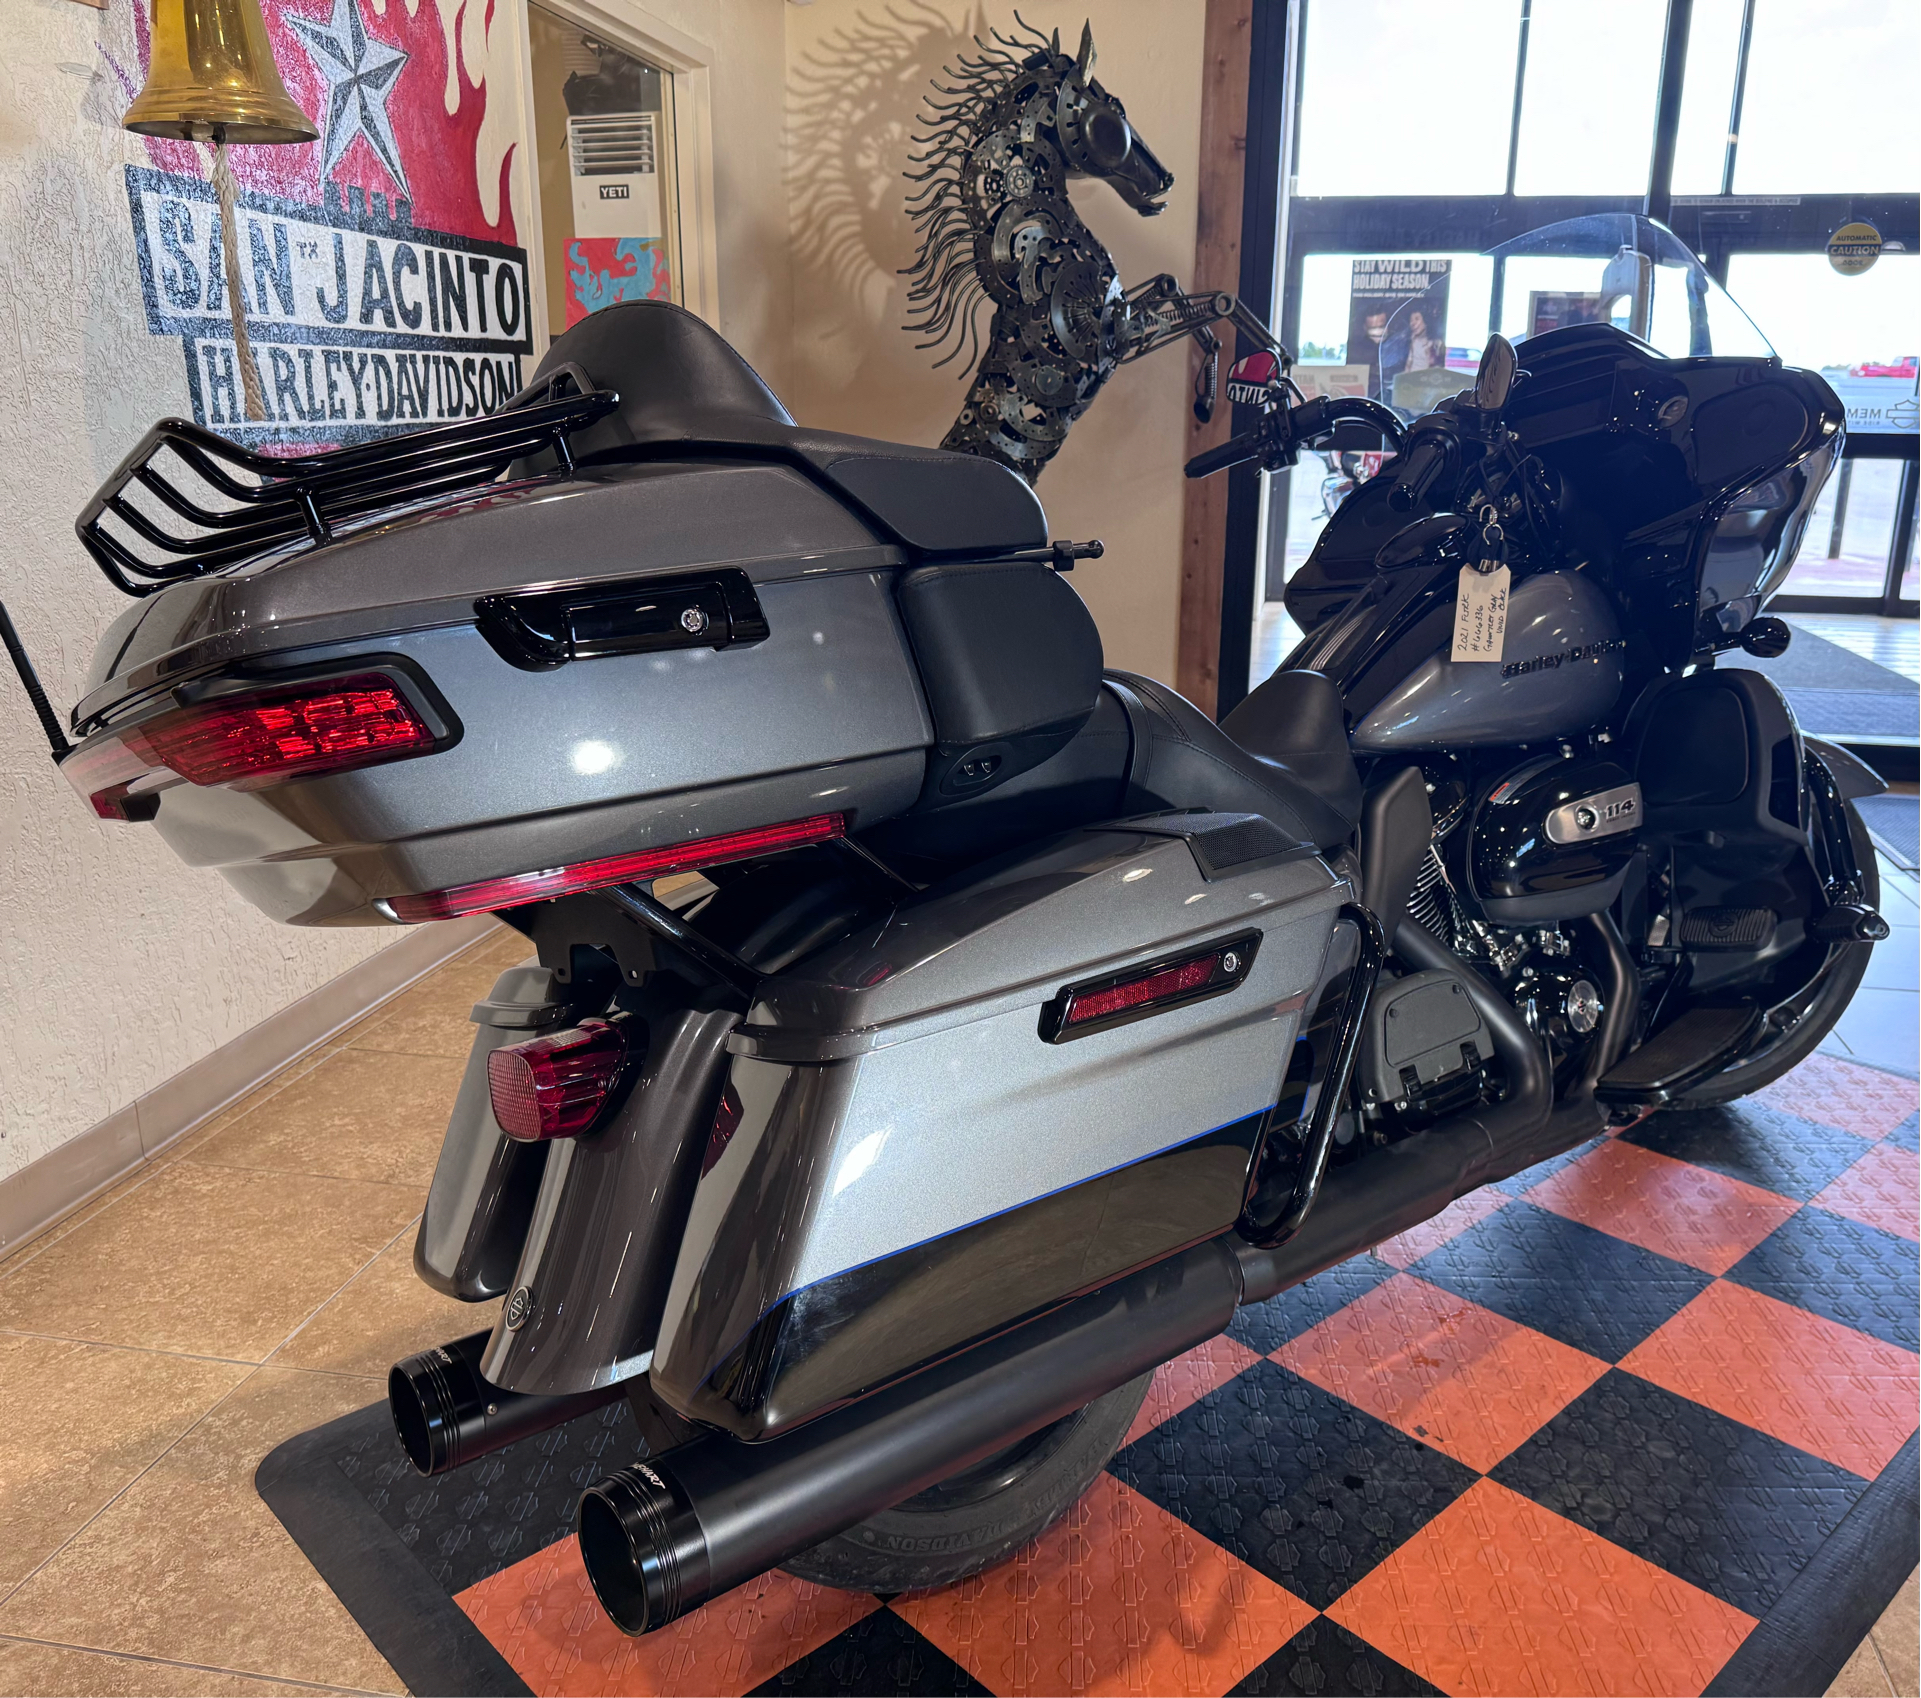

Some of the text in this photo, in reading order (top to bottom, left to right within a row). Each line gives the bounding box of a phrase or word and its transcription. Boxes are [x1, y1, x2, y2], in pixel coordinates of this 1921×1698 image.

[600, 186, 628, 198] YETI
[1835, 234, 1877, 242] AUTOMATIC
[296, 240, 319, 259] TX
[1830, 245, 1879, 255] CAUTION
[159, 200, 520, 337] SAN JACINTO
[1353, 259, 1448, 273] STAY WILD THIS
[1353, 273, 1392, 289] HOLIDAY
[1457, 627, 1469, 651] 2021
[1604, 797, 1636, 820] 114
